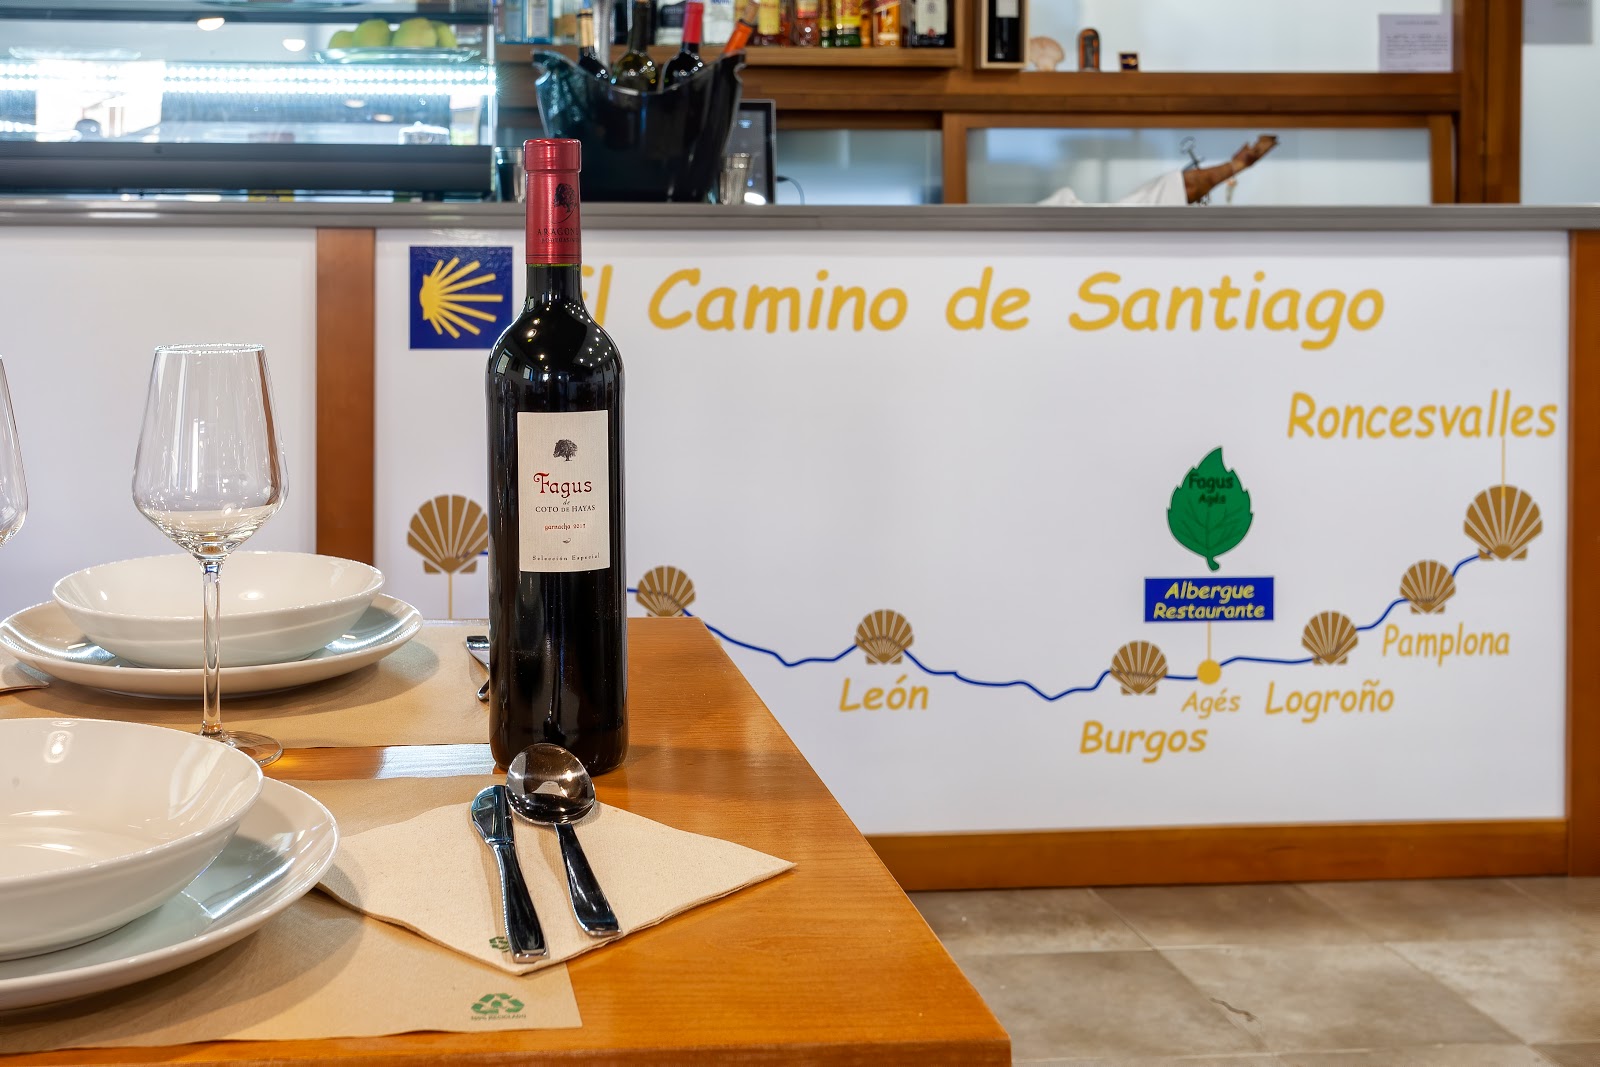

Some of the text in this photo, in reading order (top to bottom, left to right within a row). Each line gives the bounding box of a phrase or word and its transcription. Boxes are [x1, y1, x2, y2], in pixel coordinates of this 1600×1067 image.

[648, 268, 908, 333] Camino
[946, 267, 1031, 332] de
[1069, 271, 1385, 351] Santiago
[1287, 389, 1558, 440] Roncesvalles
[533, 472, 593, 498] Fagus
[1188, 473, 1234, 494] Fagus
[571, 505, 596, 513] HAYAS
[544, 522, 571, 531] garnacha
[571, 552, 600, 562] Especial
[1165, 580, 1255, 604] Albergue
[1153, 602, 1265, 619] Restaurante
[1382, 622, 1510, 666] Pamplona
[839, 678, 930, 713] León
[1181, 688, 1241, 719] Agés
[1265, 679, 1395, 724] Logroño
[1080, 721, 1208, 764] Burgos
